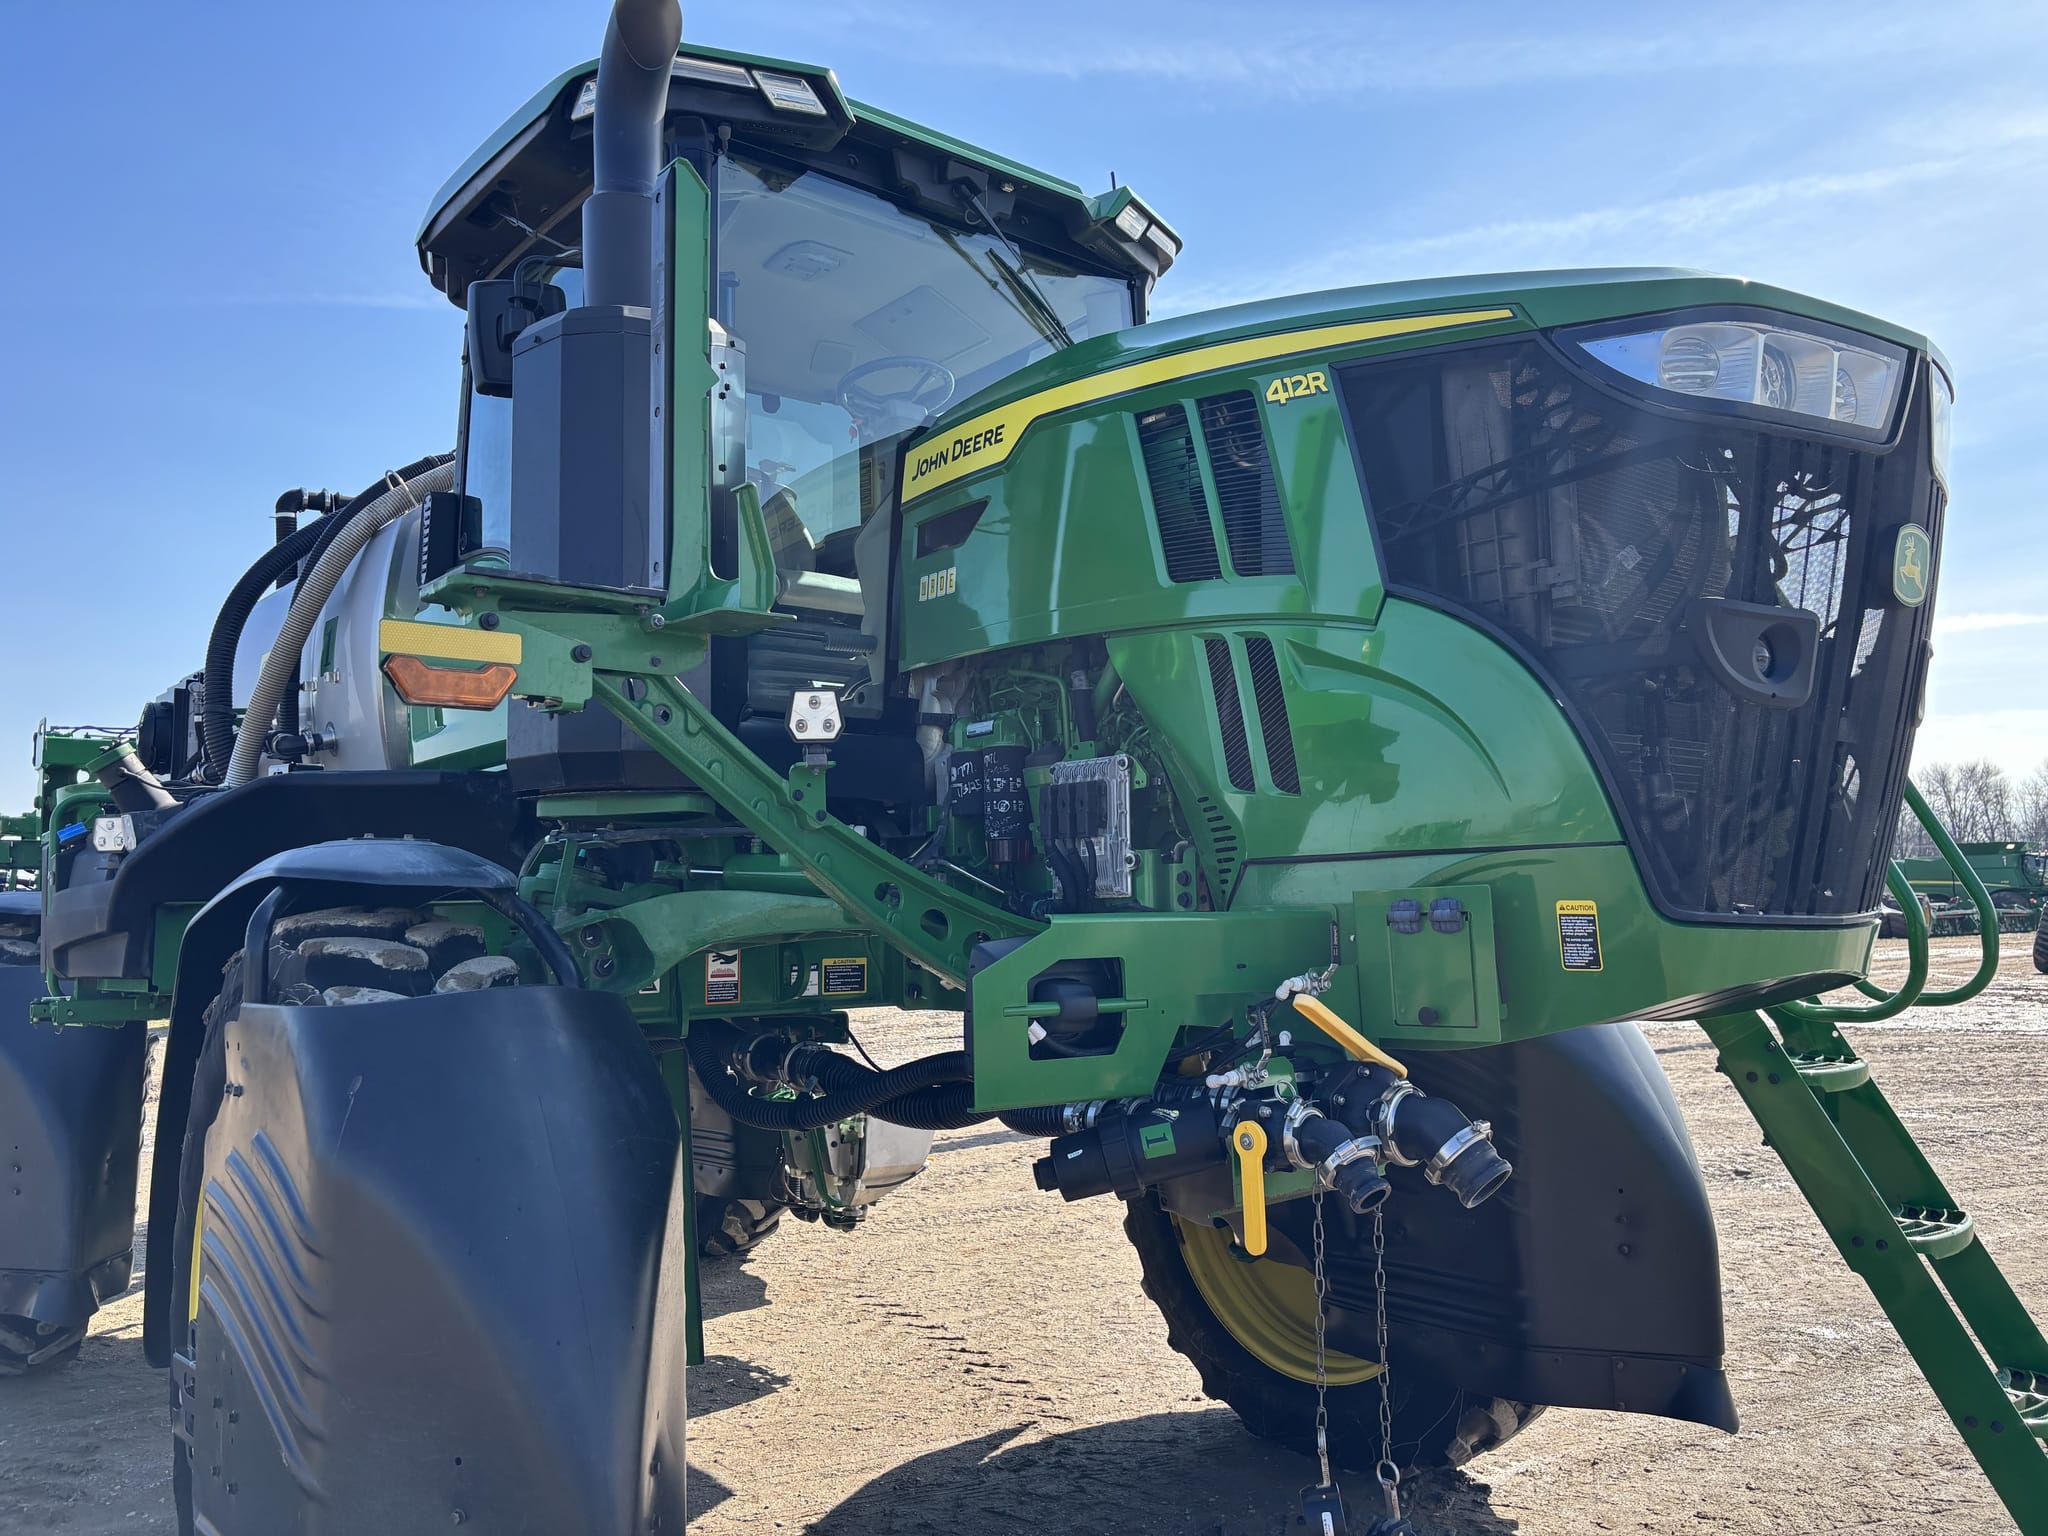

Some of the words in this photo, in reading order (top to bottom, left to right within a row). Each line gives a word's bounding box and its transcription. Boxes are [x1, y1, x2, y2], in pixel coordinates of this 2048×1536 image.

[1265, 371, 1329, 405] 412R
[911, 447, 950, 481] JOHN
[952, 423, 1005, 462] DEERE
